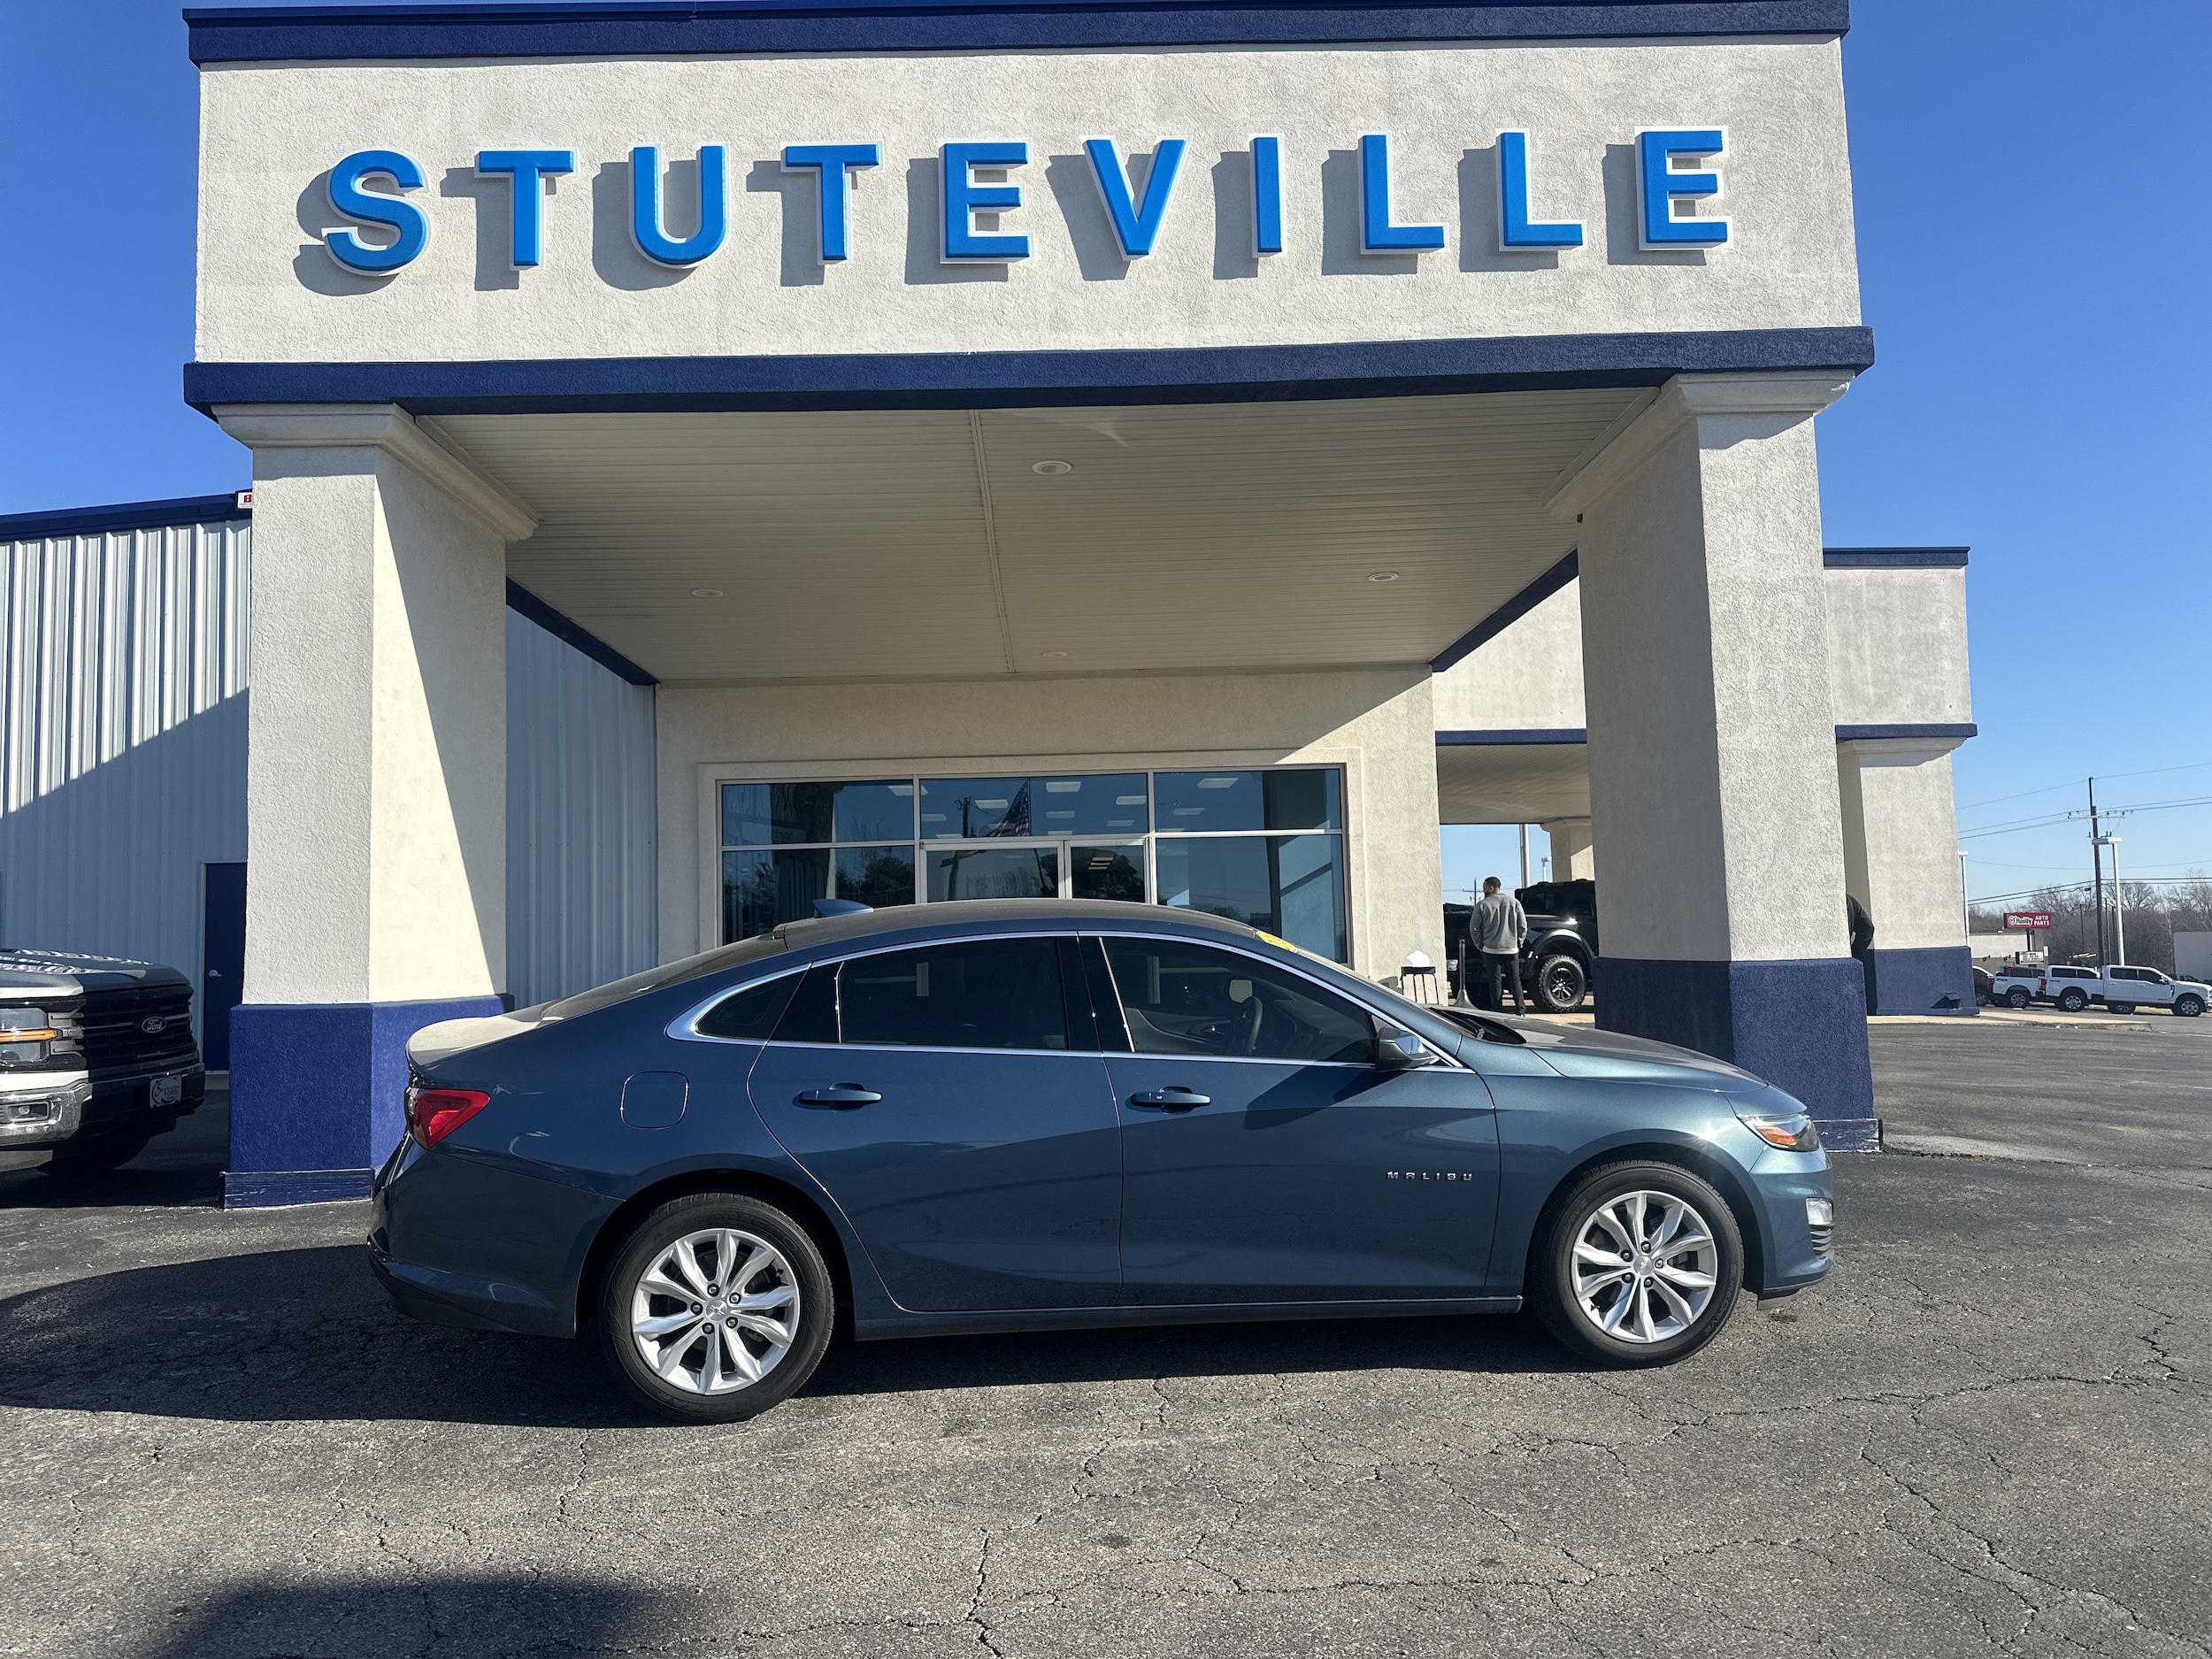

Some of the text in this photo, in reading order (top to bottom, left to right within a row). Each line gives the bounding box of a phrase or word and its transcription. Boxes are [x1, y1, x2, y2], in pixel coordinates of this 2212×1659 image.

[323, 126, 1732, 276] STUTEVILLE
[147, 1018, 163, 1031] Ford
[1386, 1171, 1472, 1181] MALIBU
